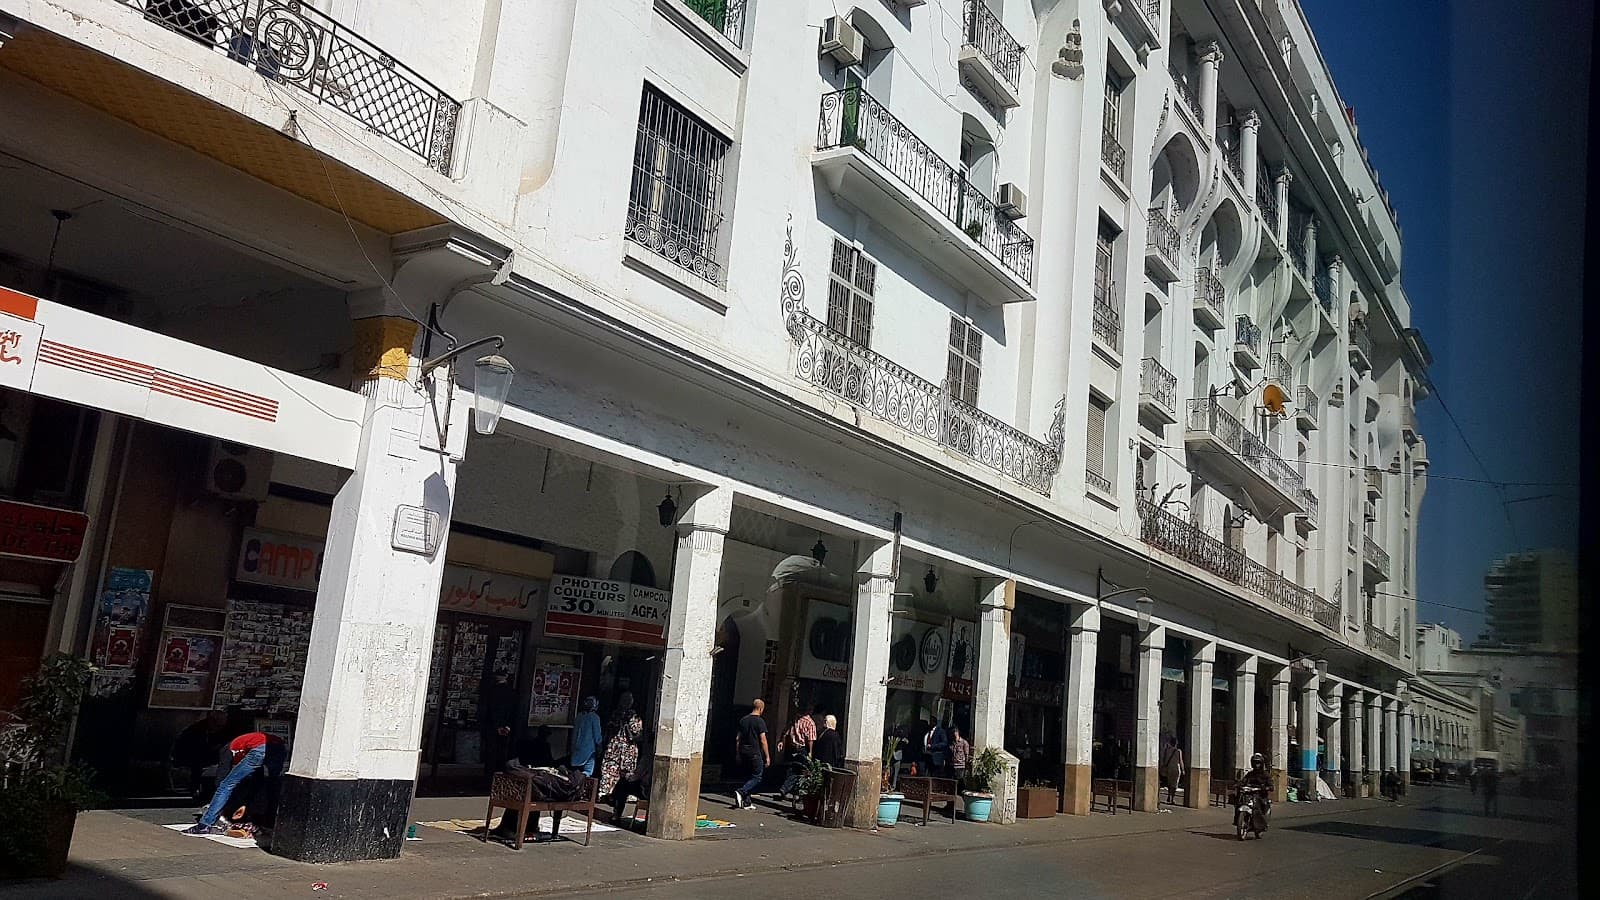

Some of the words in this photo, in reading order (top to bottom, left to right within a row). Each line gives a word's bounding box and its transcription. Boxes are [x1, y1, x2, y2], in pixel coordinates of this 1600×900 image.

[561, 577, 620, 592] PHOTOS
[553, 586, 627, 602] COULEURS
[561, 596, 595, 614] 30
[631, 604, 658, 620] AGFA
